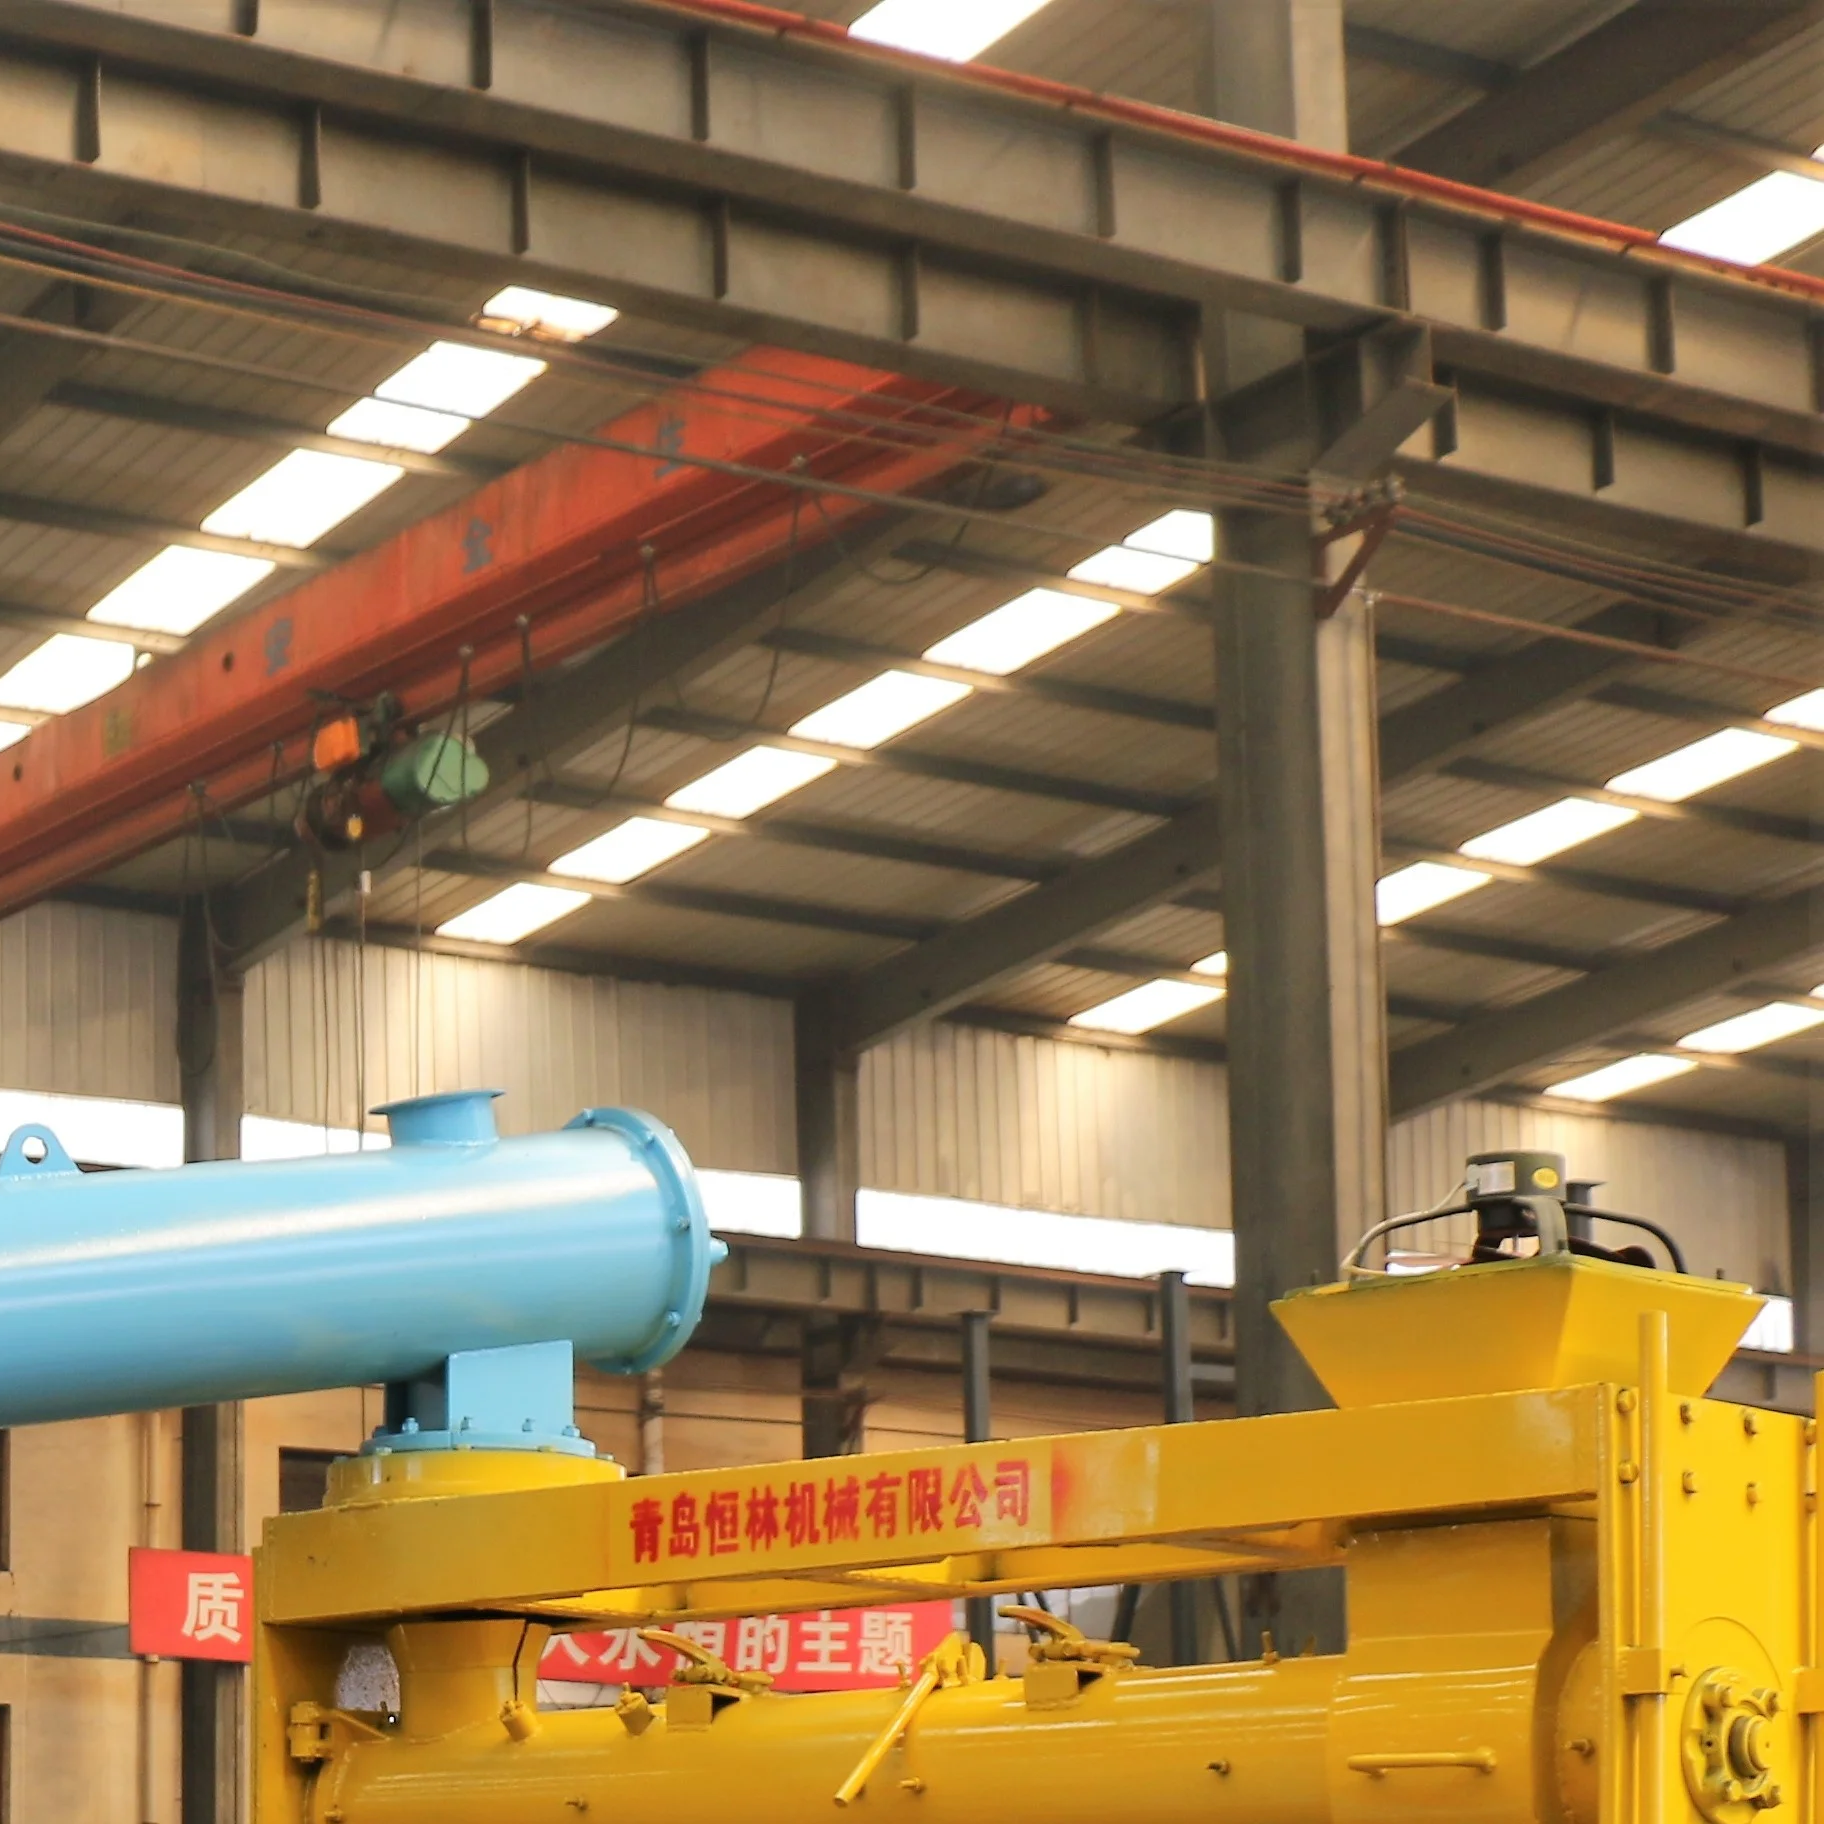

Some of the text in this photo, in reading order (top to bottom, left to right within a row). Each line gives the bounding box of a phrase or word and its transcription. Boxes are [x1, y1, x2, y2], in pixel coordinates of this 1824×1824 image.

[629, 1459, 1031, 1563] 青岛恒林机械有限公司
[181, 1572, 244, 1643] 质
